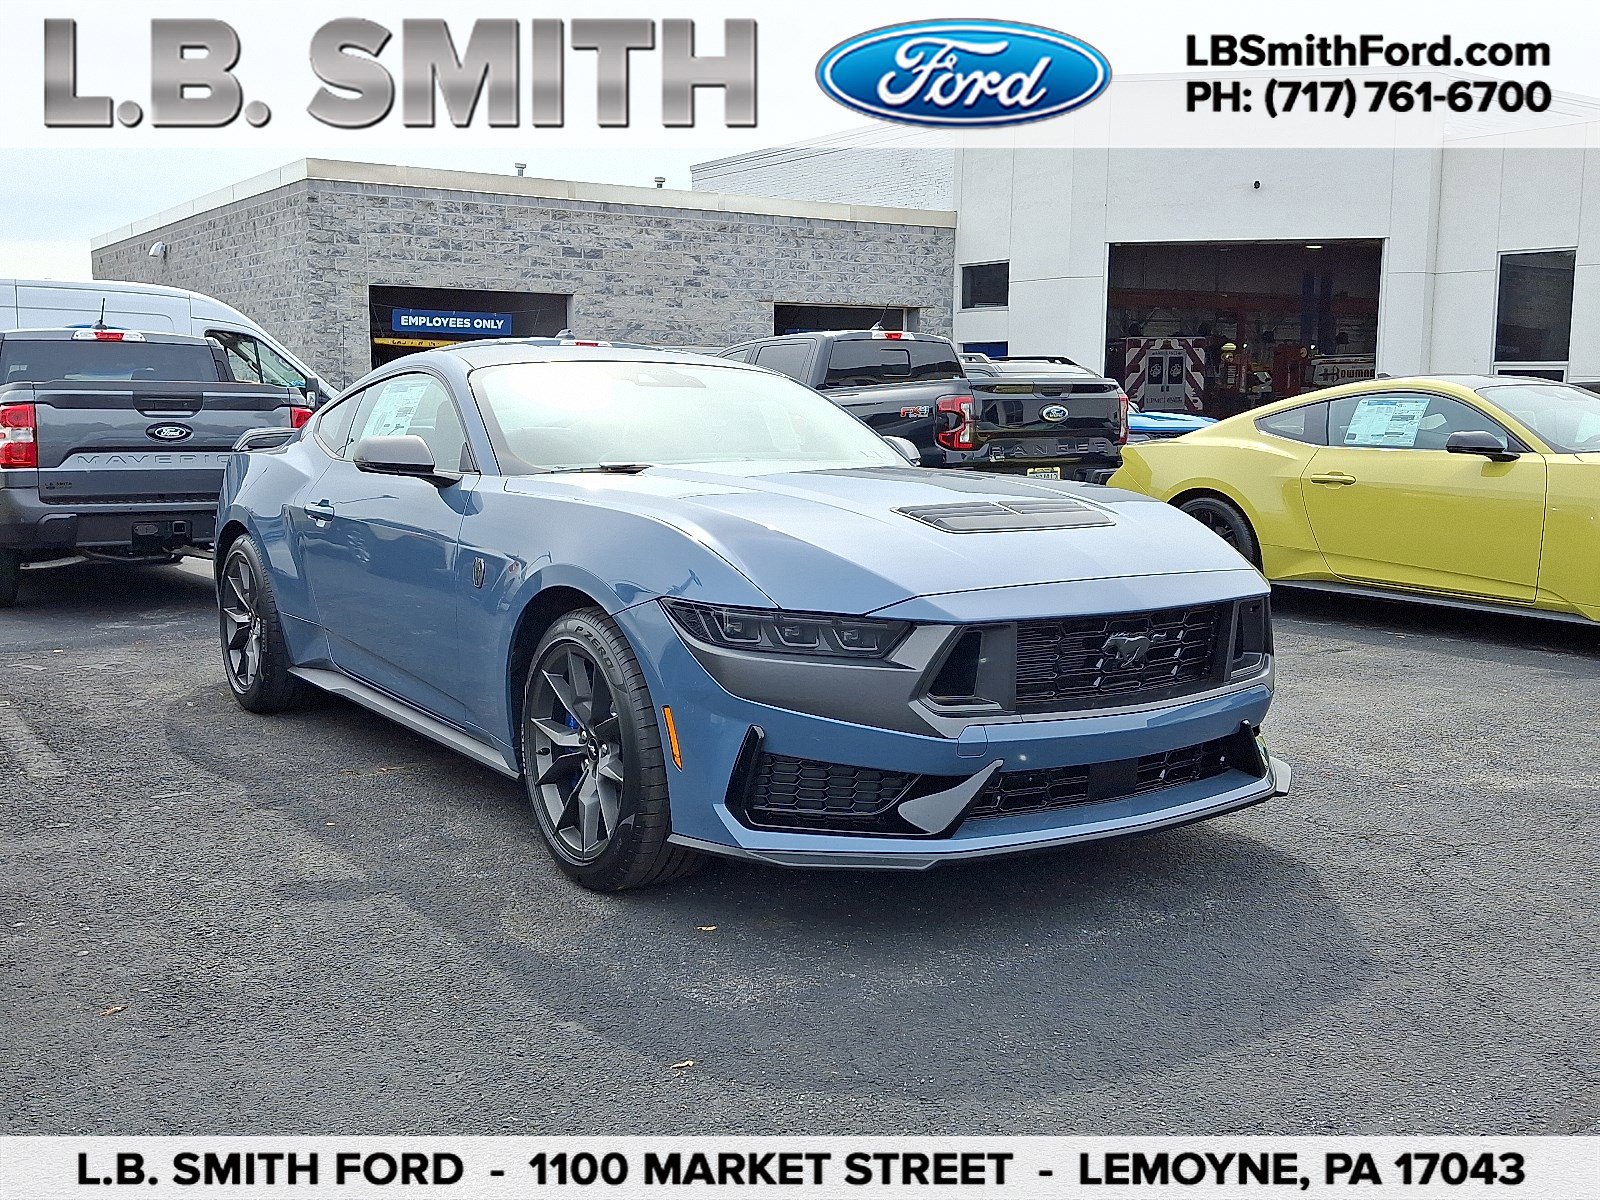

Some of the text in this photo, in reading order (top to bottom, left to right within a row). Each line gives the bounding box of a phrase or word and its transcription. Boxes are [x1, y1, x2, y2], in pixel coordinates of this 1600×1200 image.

[400, 315, 504, 330] EMPLOYEES ONLY
[990, 441, 1108, 457] RANGER
[574, 625, 615, 669] P ZERO
